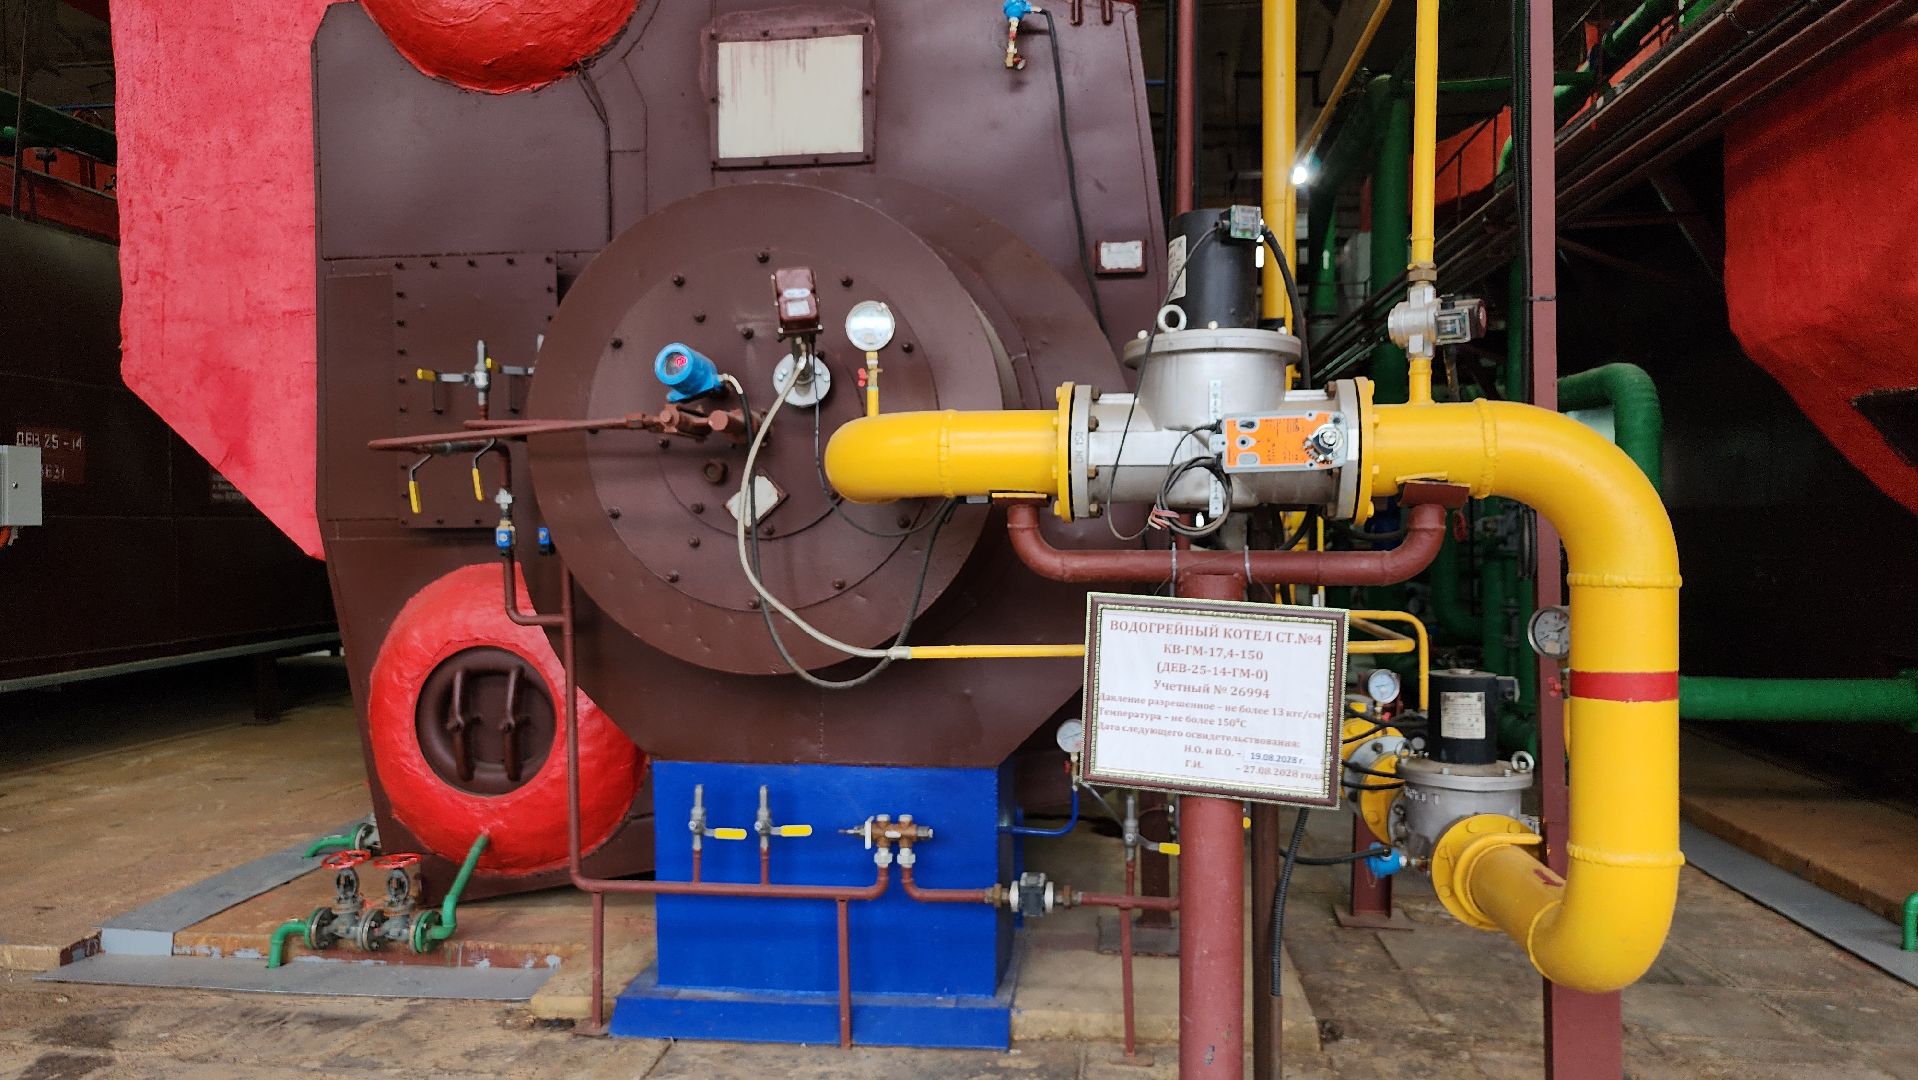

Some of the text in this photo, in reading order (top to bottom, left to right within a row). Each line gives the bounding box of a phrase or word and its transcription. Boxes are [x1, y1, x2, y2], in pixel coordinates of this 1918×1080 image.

[44, 433, 59, 449] 25
[72, 437, 82, 451] 14
[1110, 619, 1323, 646] ВОДОГРЕЙНЫЙ КОТЕЛ СТ.№4
[1163, 643, 1264, 661] КВ-ГМ-17,4-150
[1153, 679, 1270, 699] Учетный № 26994
[1099, 707, 1162, 722] Температура
[1171, 714, 1184, 723] не
[1185, 715, 1215, 726] более
[1148, 699, 1216, 711] разрешенное
[1225, 704, 1237, 712] не
[1240, 703, 1270, 716] более
[1273, 707, 1284, 717] 13
[1122, 726, 1184, 738] следующего
